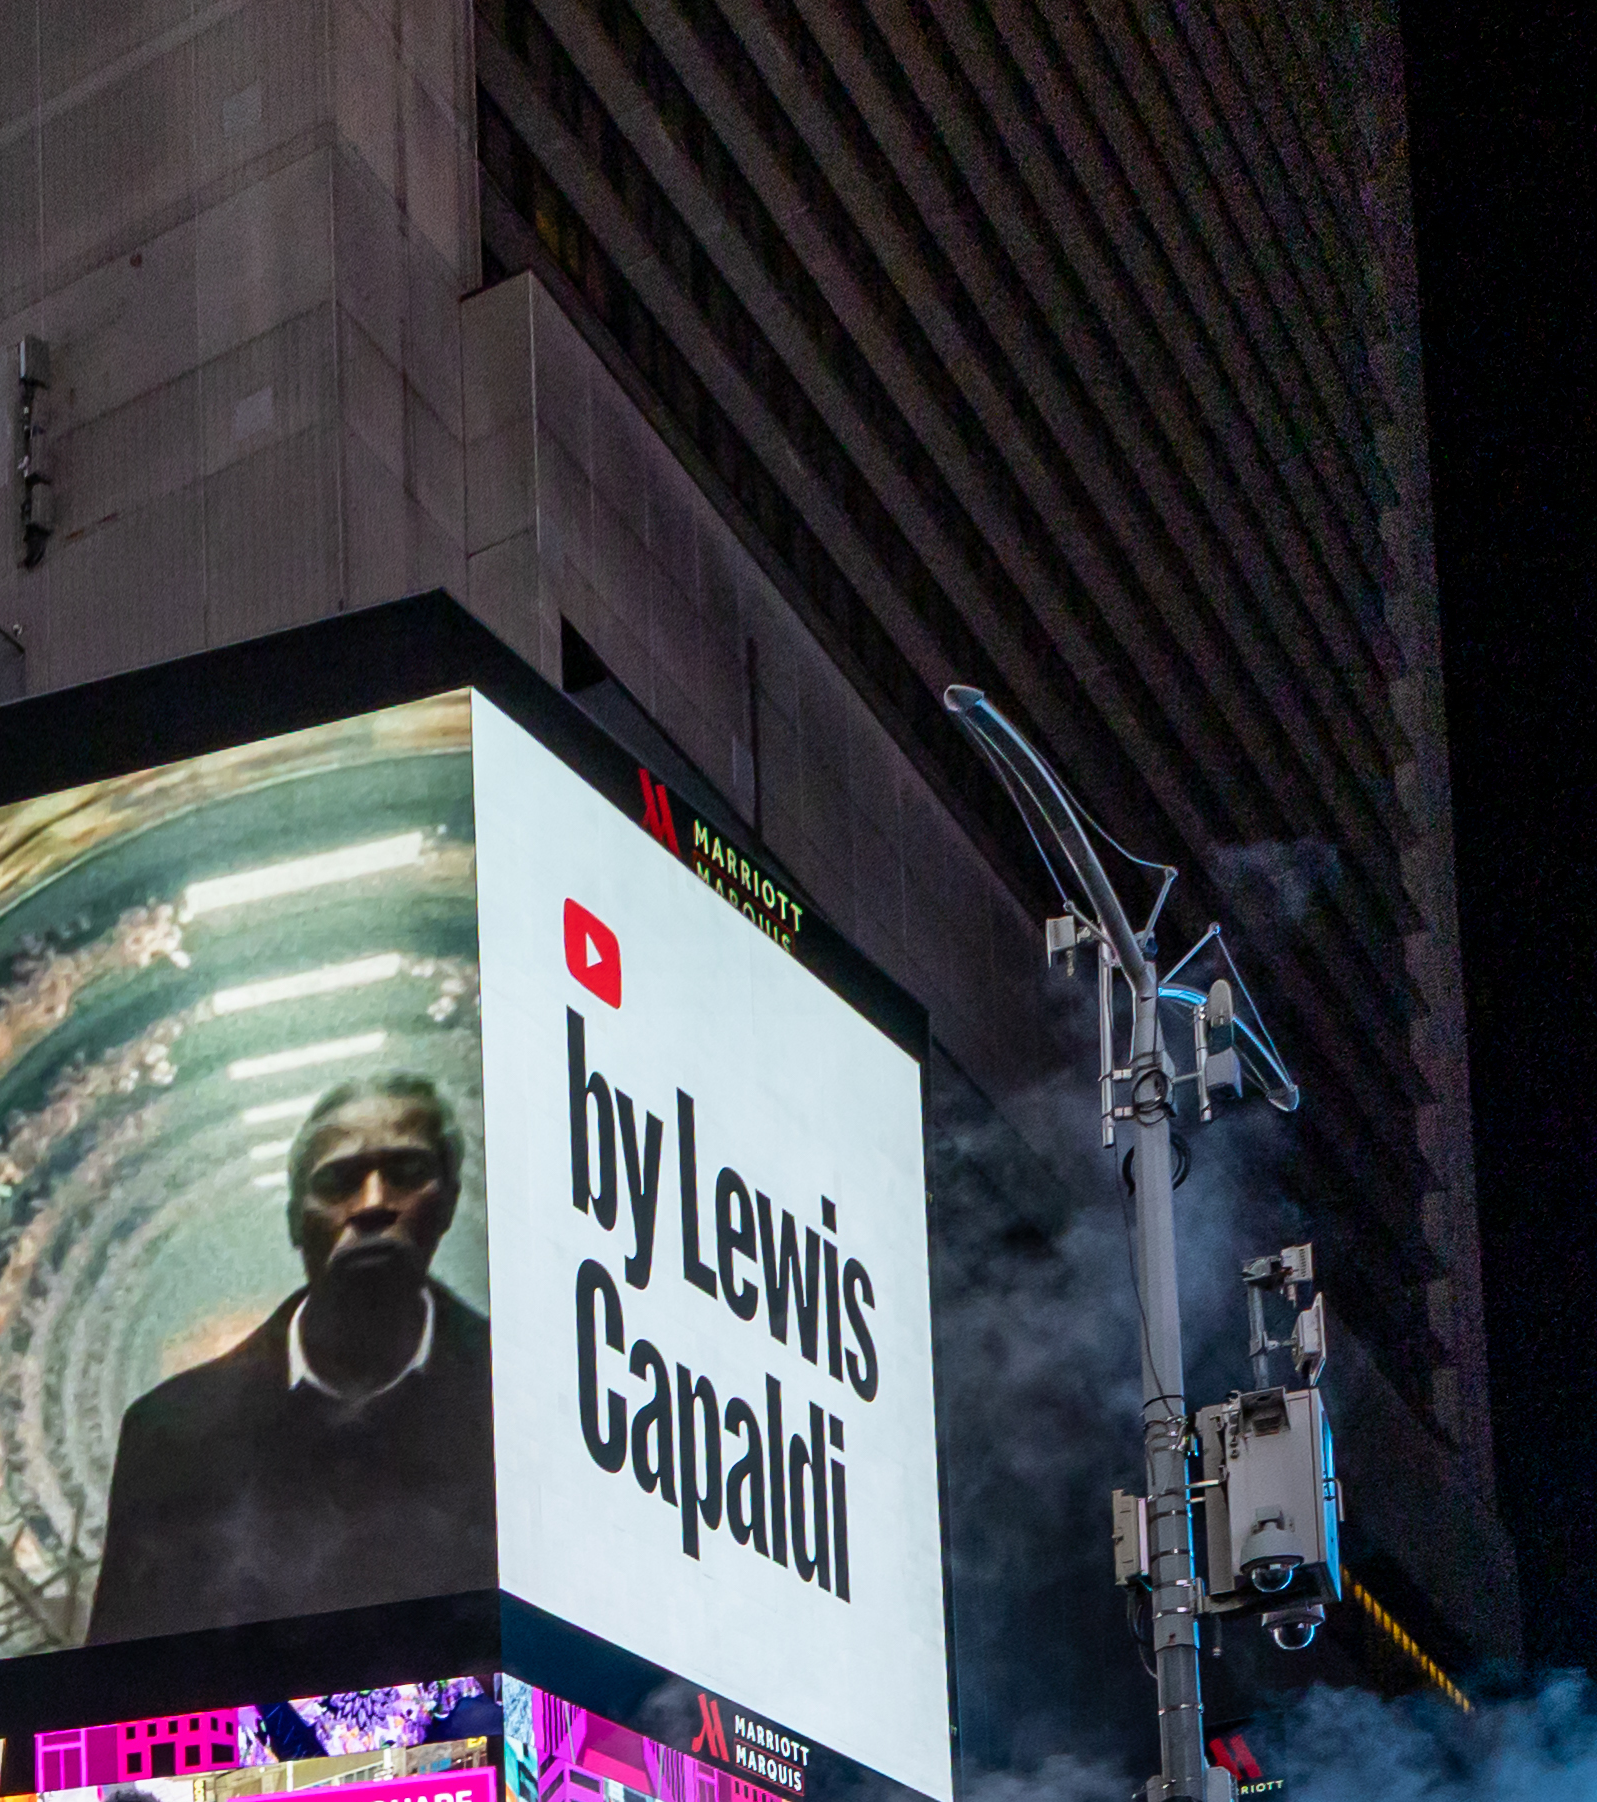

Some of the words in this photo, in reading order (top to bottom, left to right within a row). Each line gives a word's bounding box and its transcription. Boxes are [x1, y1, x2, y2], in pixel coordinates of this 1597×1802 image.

[693, 819, 803, 932] MARRIOTT
[566, 1005, 664, 1290] by
[677, 1087, 879, 1402] Lewis
[575, 1259, 851, 1604] Capaldi
[734, 1713, 810, 1769] MARRIOTT
[735, 1743, 804, 1793] MARQUIS
